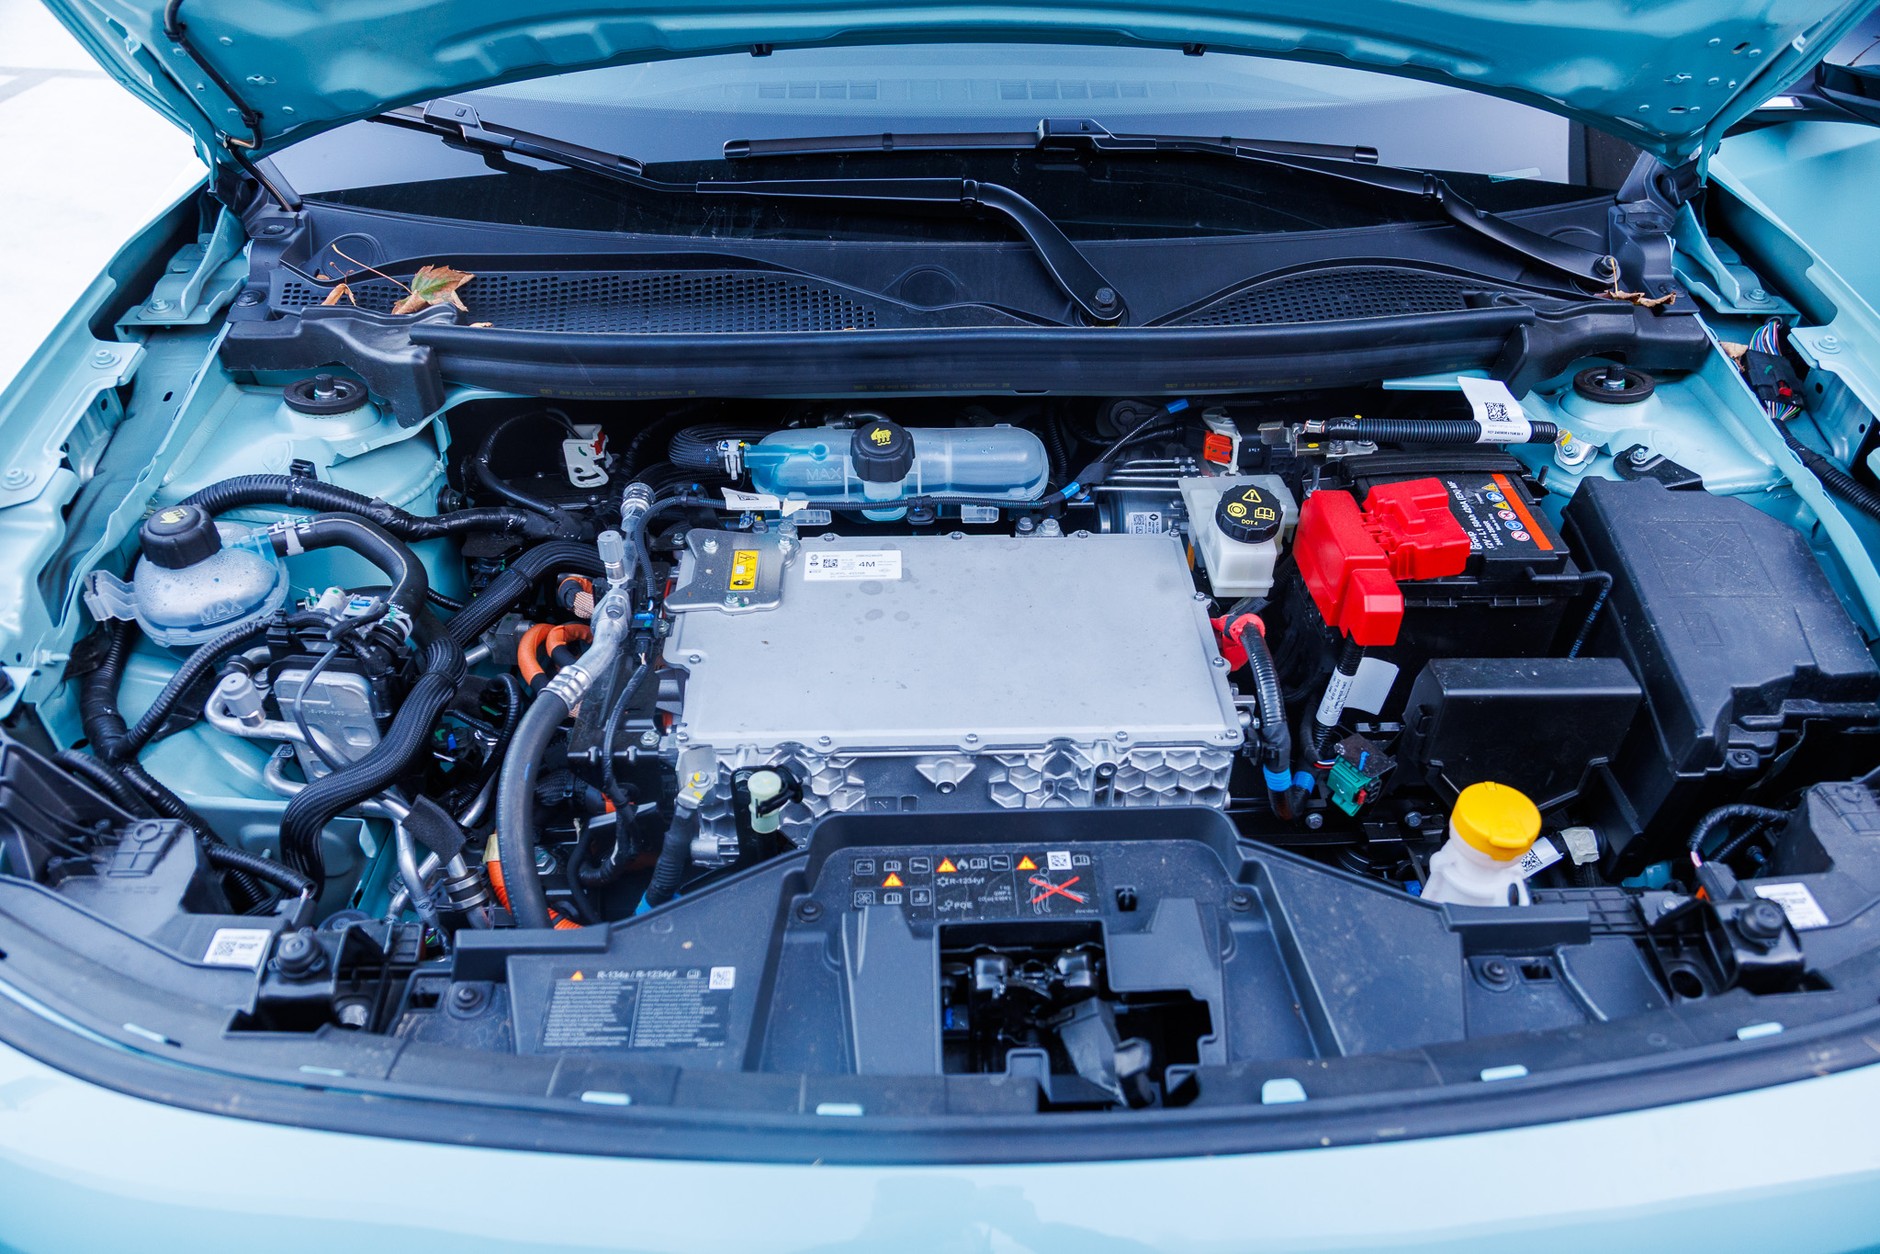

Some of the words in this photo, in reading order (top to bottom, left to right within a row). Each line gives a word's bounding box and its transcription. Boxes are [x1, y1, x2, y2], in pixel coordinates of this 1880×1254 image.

[805, 467, 842, 481] MAX
[200, 597, 243, 622] MAX
[949, 877, 985, 886] R-1234yf
[636, 969, 678, 980] R-1234yf
